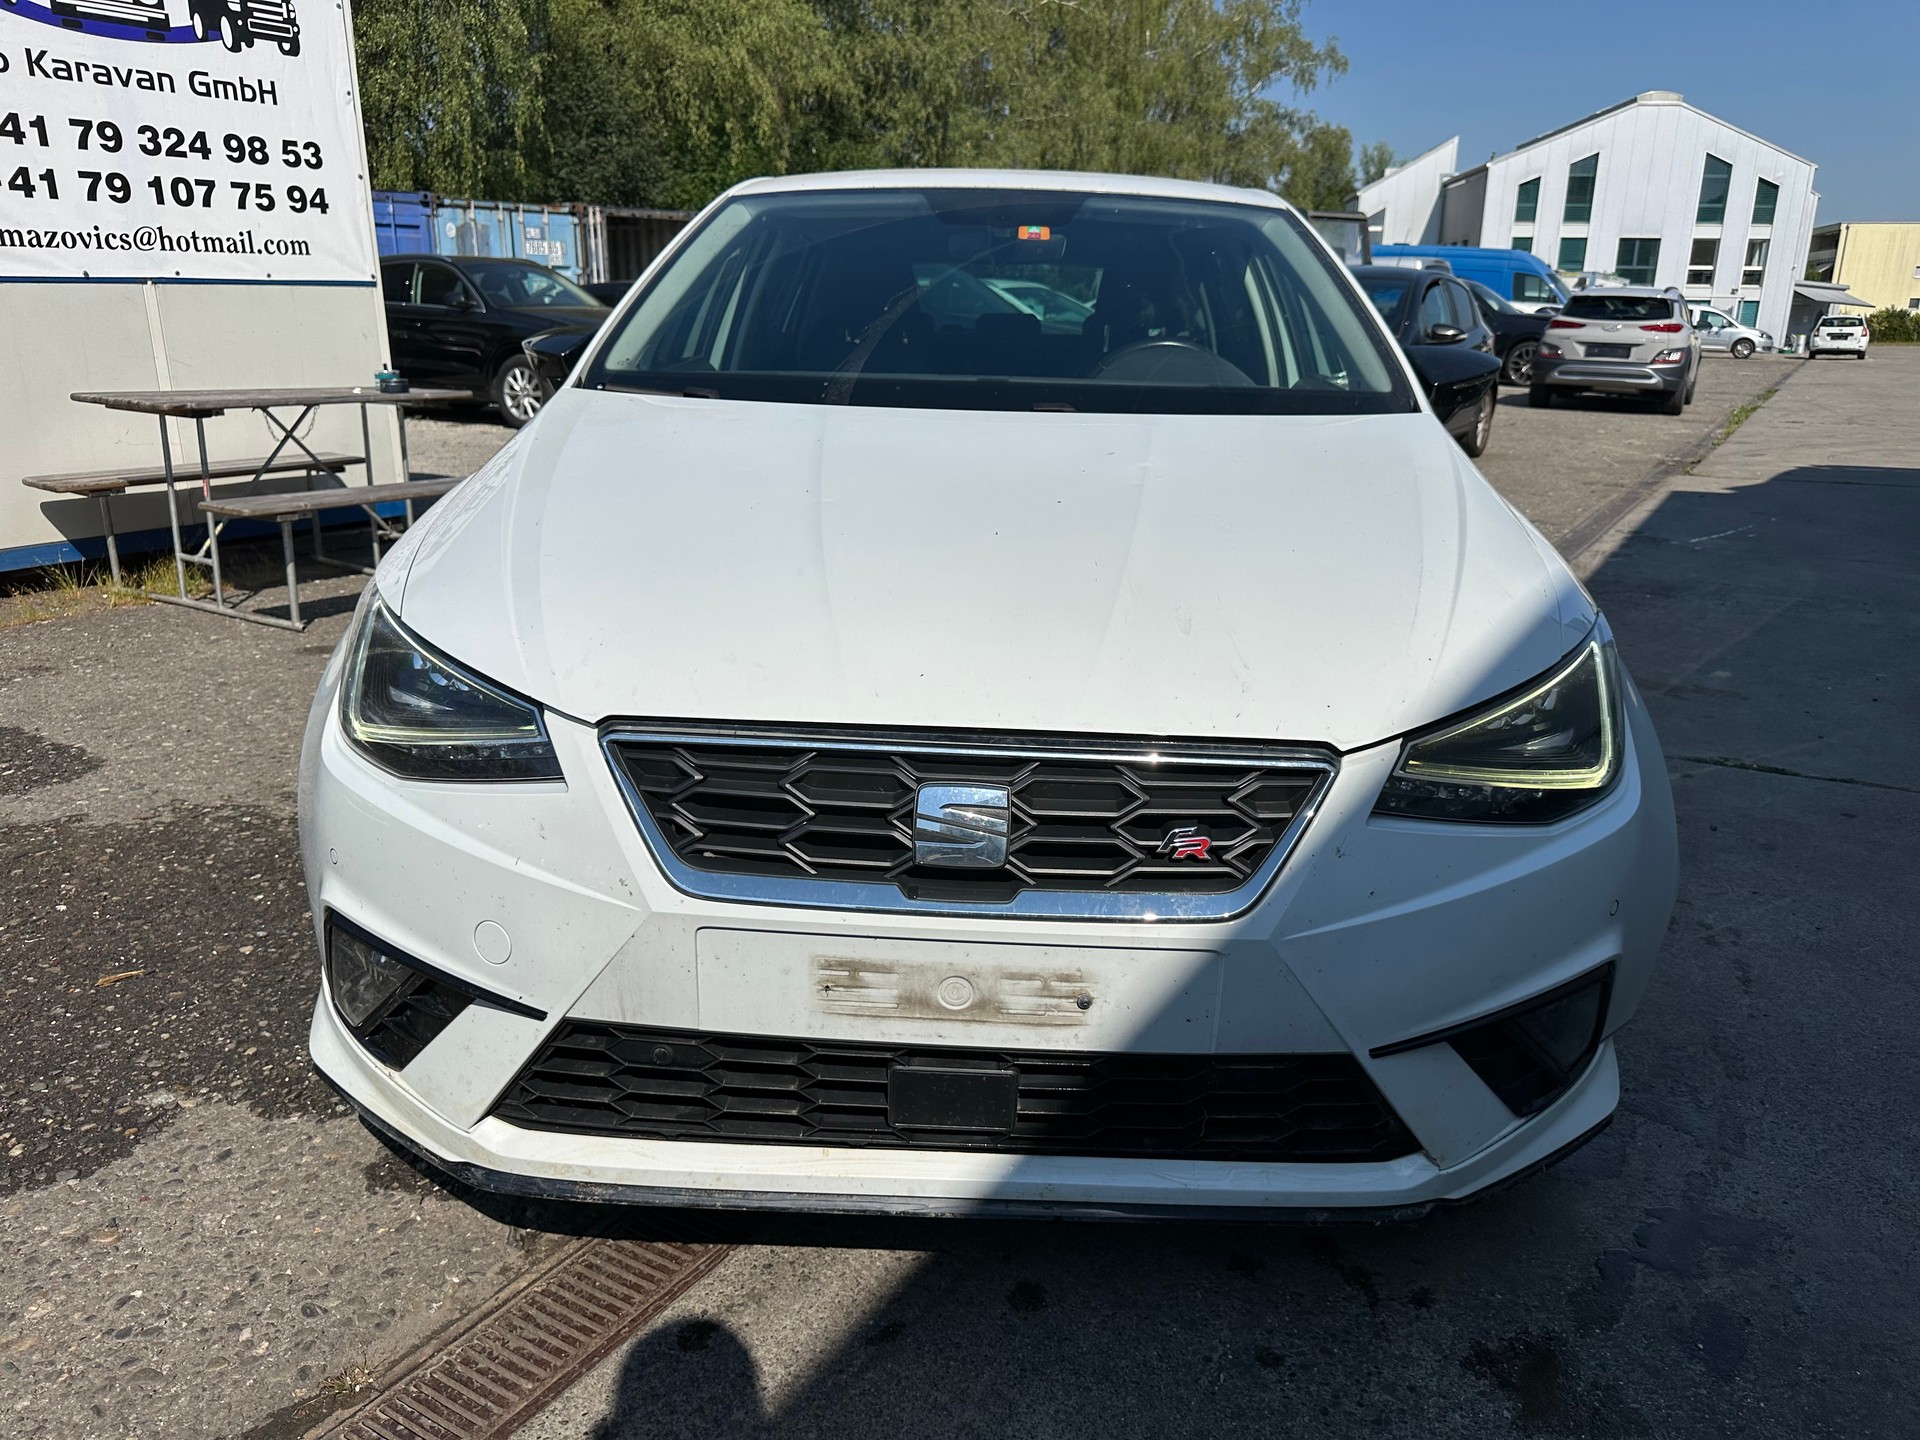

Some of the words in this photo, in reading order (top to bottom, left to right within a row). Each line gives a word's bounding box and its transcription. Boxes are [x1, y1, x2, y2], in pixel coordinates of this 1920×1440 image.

[24, 47, 176, 94] Karavan
[188, 70, 278, 106] GmbH
[68, 117, 123, 154] 79
[137, 124, 212, 161] 324
[222, 133, 270, 166] 98
[281, 139, 323, 170] 53
[0, 166, 59, 200] 41
[77, 170, 132, 204] 79
[147, 175, 216, 208] 107
[229, 181, 276, 212] 75
[286, 185, 330, 215] 94
[0, 224, 311, 256] mazovics@hotmail.com
